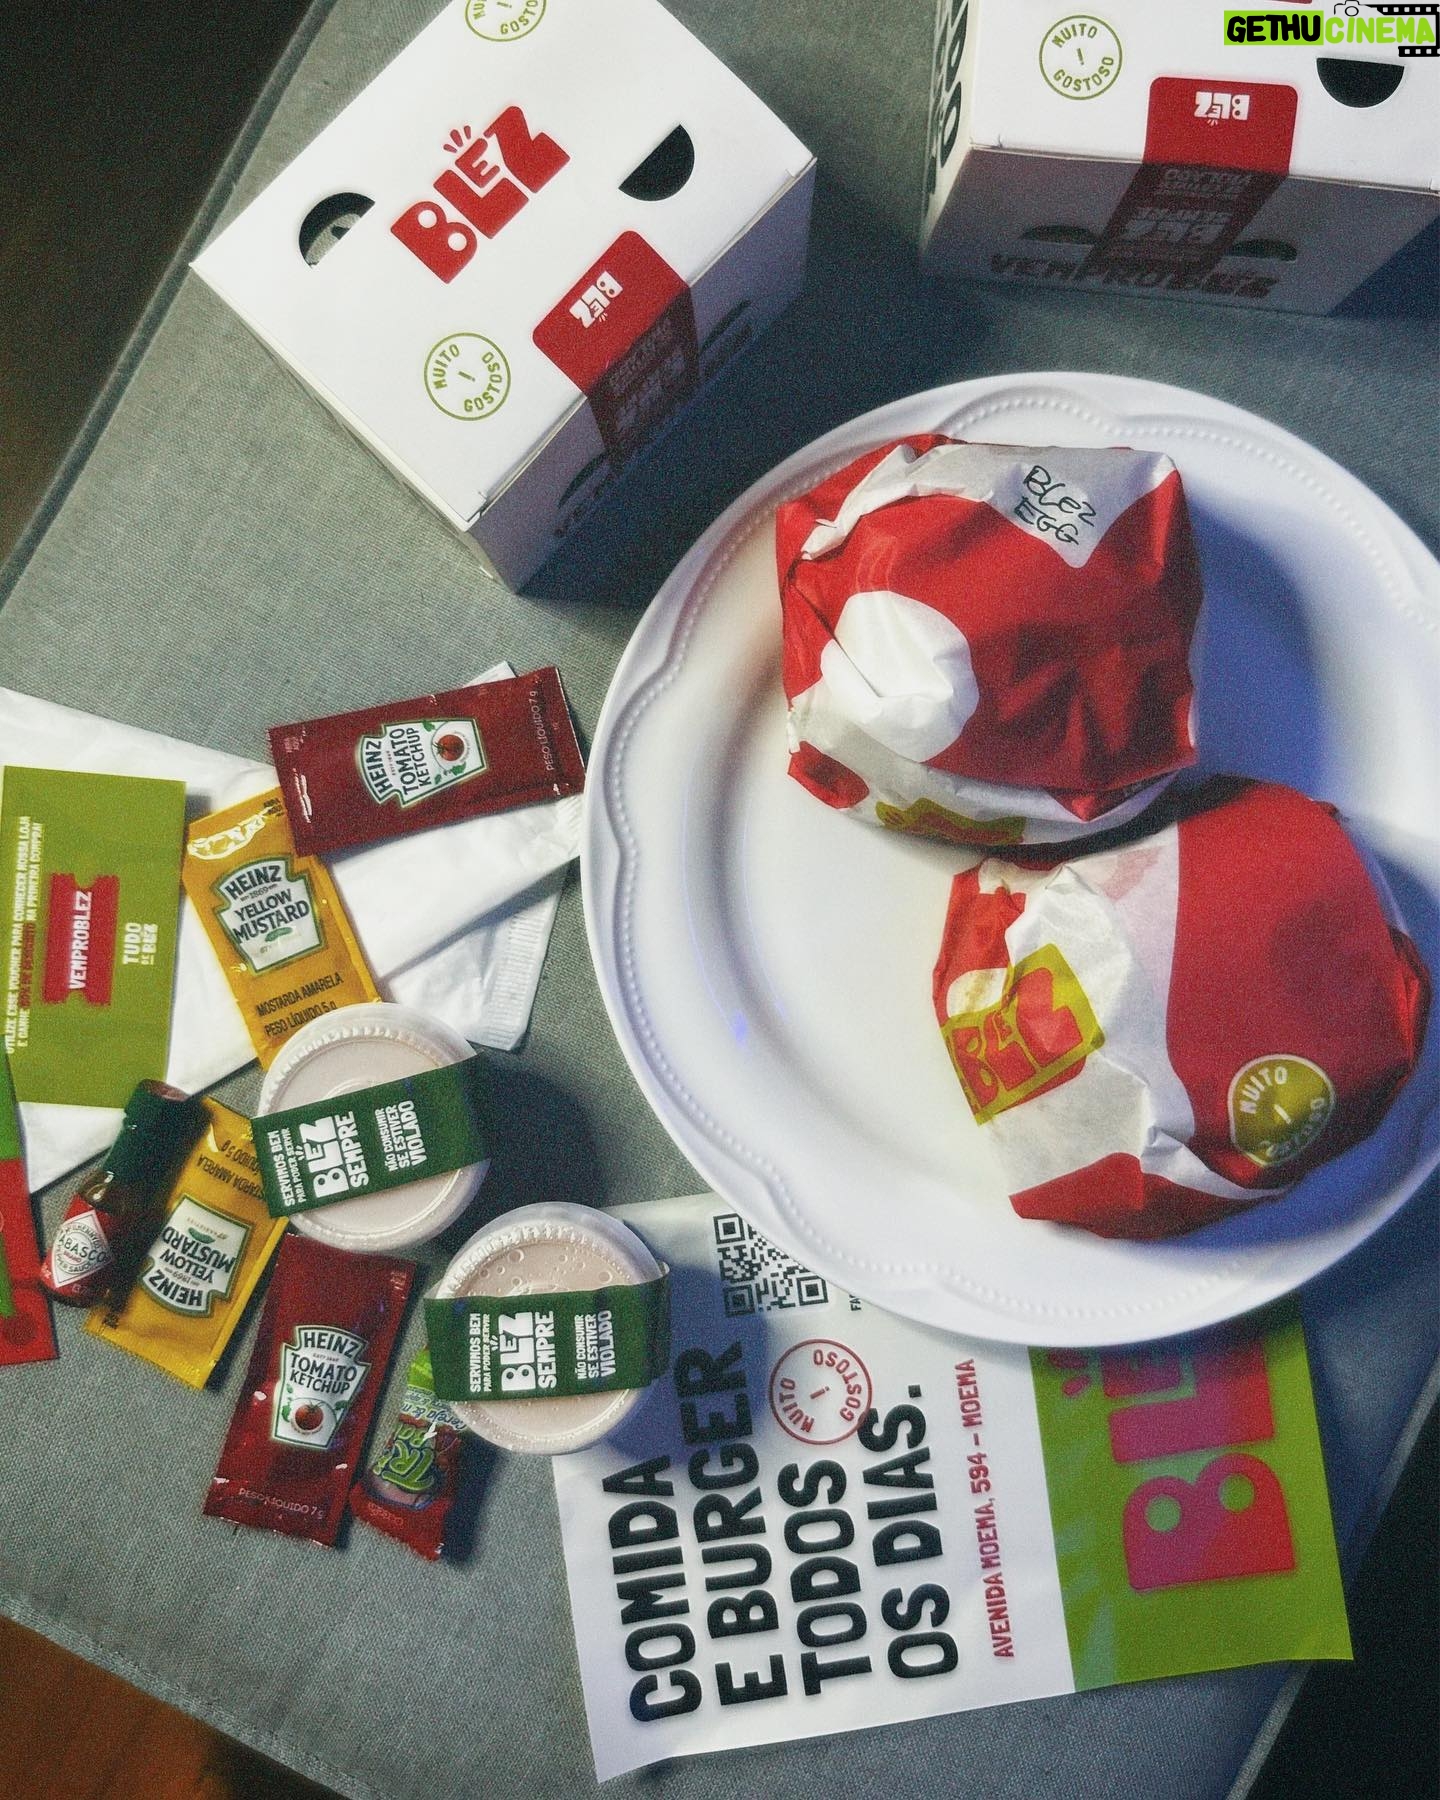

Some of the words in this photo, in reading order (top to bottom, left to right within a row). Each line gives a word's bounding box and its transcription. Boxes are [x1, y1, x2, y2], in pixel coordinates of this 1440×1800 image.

[500, 0, 538, 34] GOSTO
[1053, 23, 1098, 47] MUITO
[1054, 55, 1114, 92] GOSTOSO
[1195, 91, 1250, 121] BLEZ
[390, 105, 571, 284] BLEZ
[569, 271, 623, 328] BLEZ
[432, 343, 461, 391] MUITO
[463, 351, 503, 413] GOSTOSO
[1014, 496, 1079, 545] EGG
[366, 740, 392, 794] HEINZ
[389, 728, 419, 795] TOMATO
[407, 727, 431, 788] KETCHUP
[225, 865, 283, 900] HEINZ
[233, 889, 292, 922] YELLOW
[11, 923, 24, 946] PARA
[68, 890, 92, 990] VEMPROBLEZ
[123, 922, 142, 965] TUDO
[232, 900, 310, 944] MUSTARD
[256, 989, 303, 1017] MOSTARDA
[301, 972, 344, 998] AMARELA
[264, 1018, 288, 1037] PESO
[1239, 1065, 1288, 1116] MUITO
[267, 1131, 281, 1149] BEM
[281, 1128, 295, 1156] SERVIR
[335, 1111, 369, 1188] SEMPRE
[375, 1108, 394, 1154] CONSUMIR
[385, 1105, 407, 1153] ESTIVER
[398, 1100, 427, 1166] VIOLADO
[271, 1150, 295, 1207] SERVIMOS
[288, 1157, 301, 1180] PODER
[300, 1116, 349, 1198] BLEZ
[384, 1154, 398, 1172] NÃO
[398, 1155, 410, 1169] SE
[293, 1182, 306, 1203] PARA
[59, 1234, 107, 1264] ABASCO
[159, 1247, 215, 1283] YELLOW
[161, 1226, 236, 1274] MUSTARD
[149, 1268, 203, 1308] HEINZ
[303, 1331, 360, 1358] HEINZ
[470, 1313, 481, 1337] BEM
[575, 1315, 585, 1357] CONSUMIR
[585, 1314, 598, 1360] ESTIVER
[598, 1310, 616, 1377] VIOLADO
[291, 1352, 357, 1382] TOMATO
[470, 1338, 481, 1392] SERVIMOS
[483, 1342, 491, 1369] PODER
[499, 1312, 536, 1391] BLEZ
[535, 1311, 557, 1389] SEMPRE
[576, 1358, 587, 1380] NÃO
[588, 1363, 599, 1379] SE
[289, 1373, 350, 1395] KETCHUP
[484, 1371, 492, 1392] PARA
[813, 1349, 862, 1423] GOSTOSO
[955, 1358, 983, 1428] MOEMA
[779, 1377, 814, 1434] MUITO
[674, 1341, 780, 1639] BURGER
[857, 1384, 944, 1567] DIAS.
[967, 1452, 991, 1494] 594
[1101, 1341, 1295, 1593] BLE
[973, 1496, 1002, 1569] MOEMA,
[603, 1455, 702, 1723] COMIDA
[777, 1459, 873, 1697] TODOS
[881, 1582, 958, 1680] OS
[979, 1570, 1014, 1659] AVENIDA
[714, 1654, 788, 1706] E
